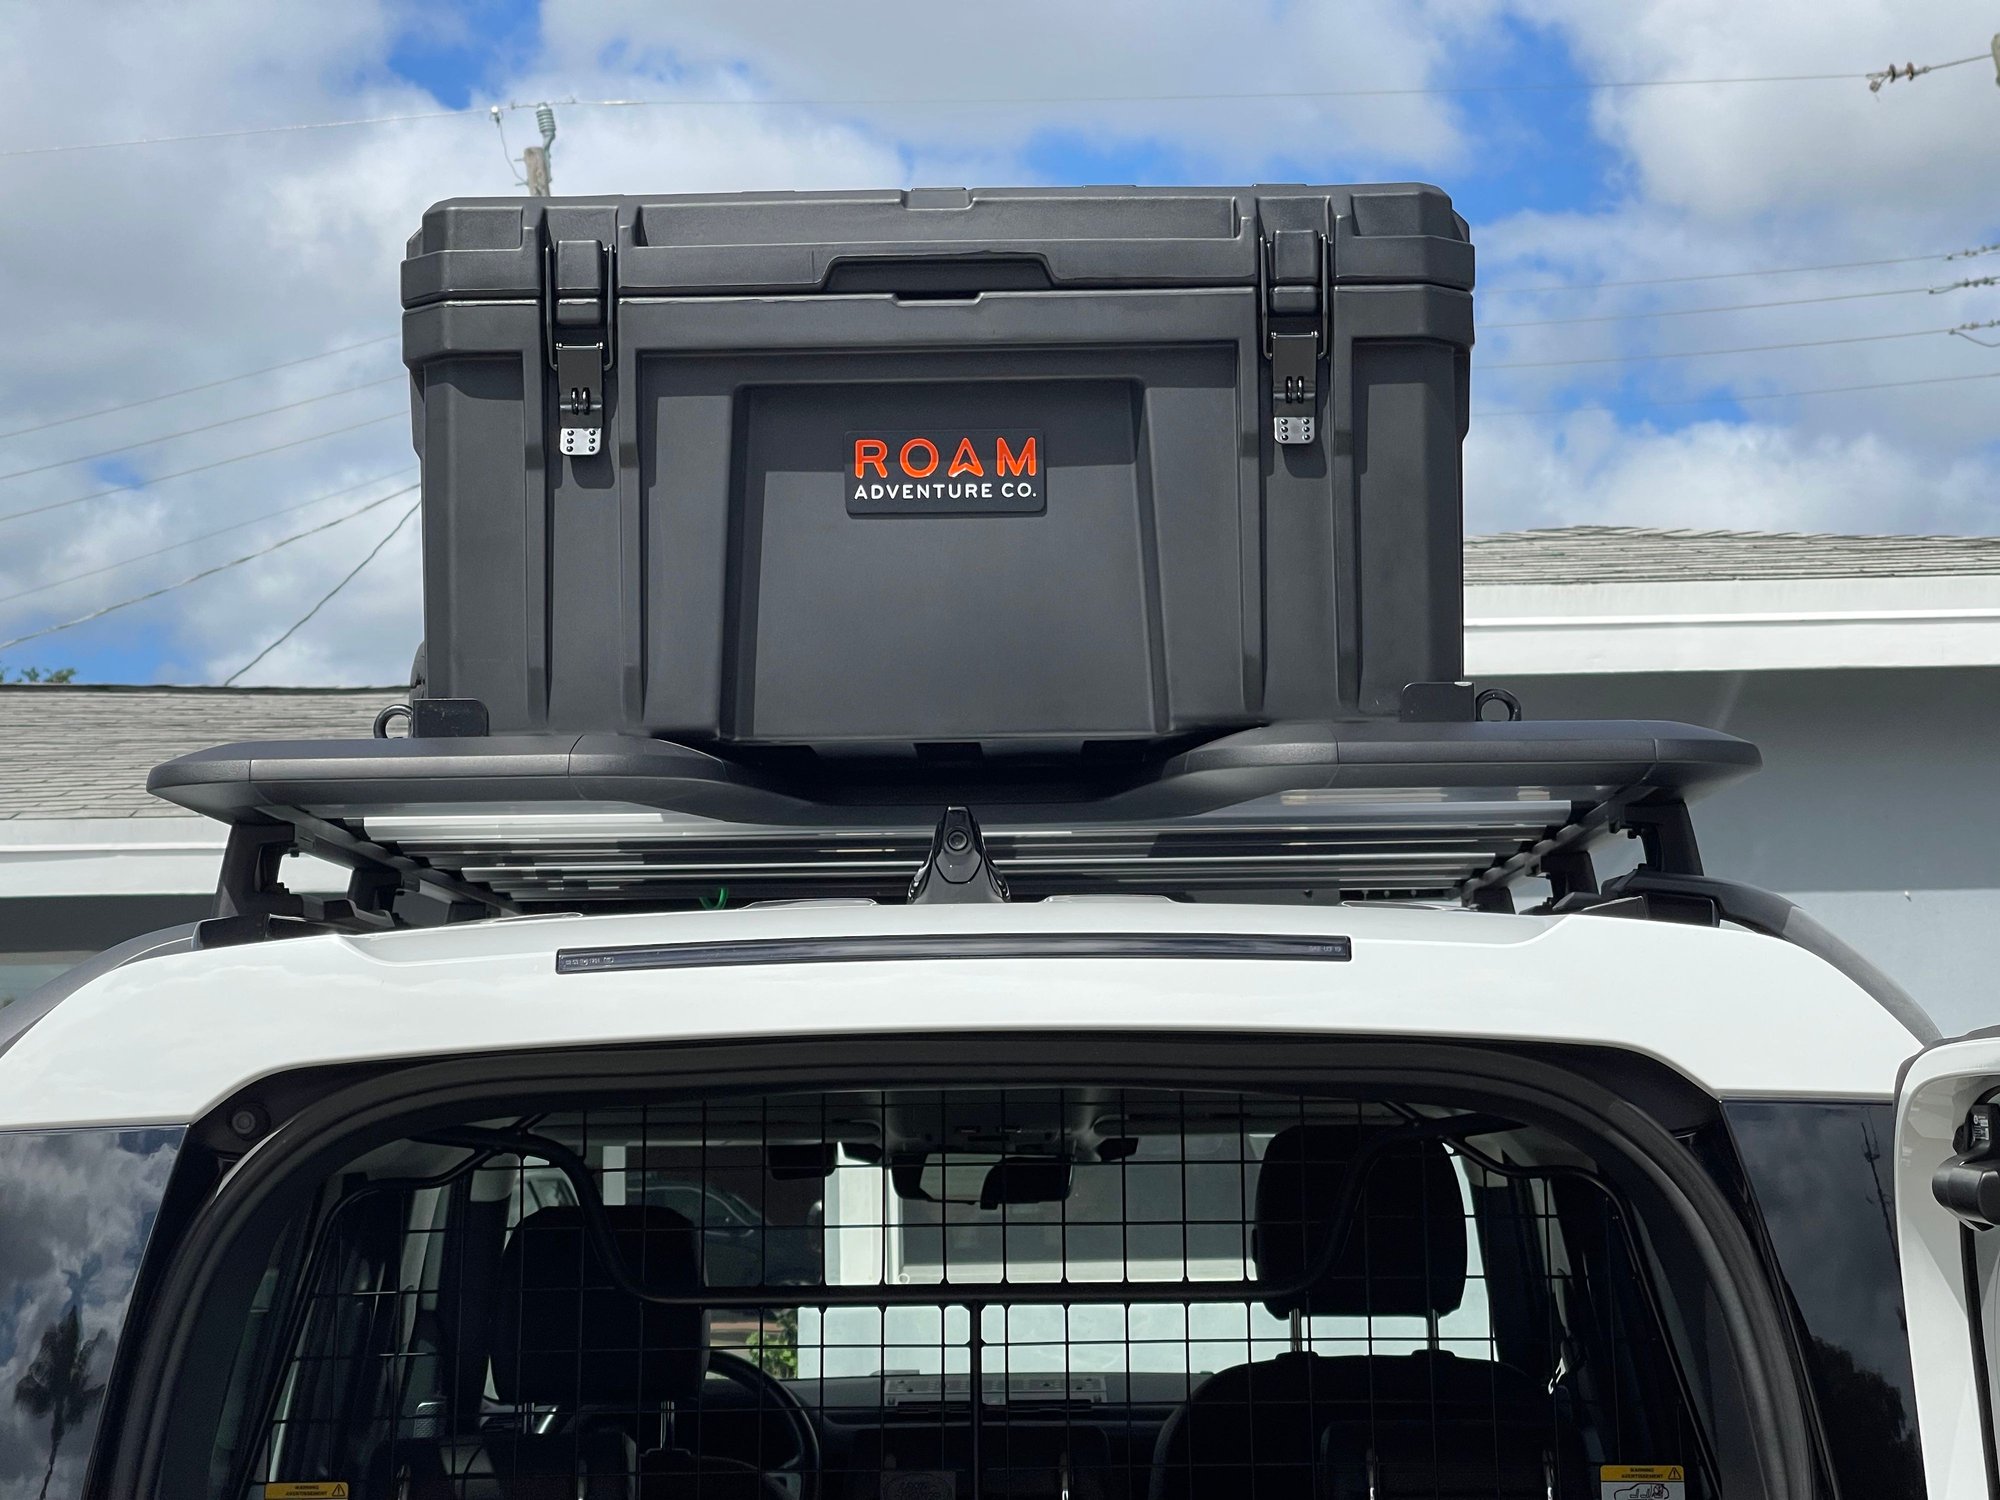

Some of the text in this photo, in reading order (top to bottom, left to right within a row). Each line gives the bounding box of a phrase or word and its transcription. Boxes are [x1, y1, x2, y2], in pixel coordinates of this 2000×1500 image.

[854, 436, 1037, 479] ROAM
[854, 482, 1037, 500] ADVENTURE CO.
